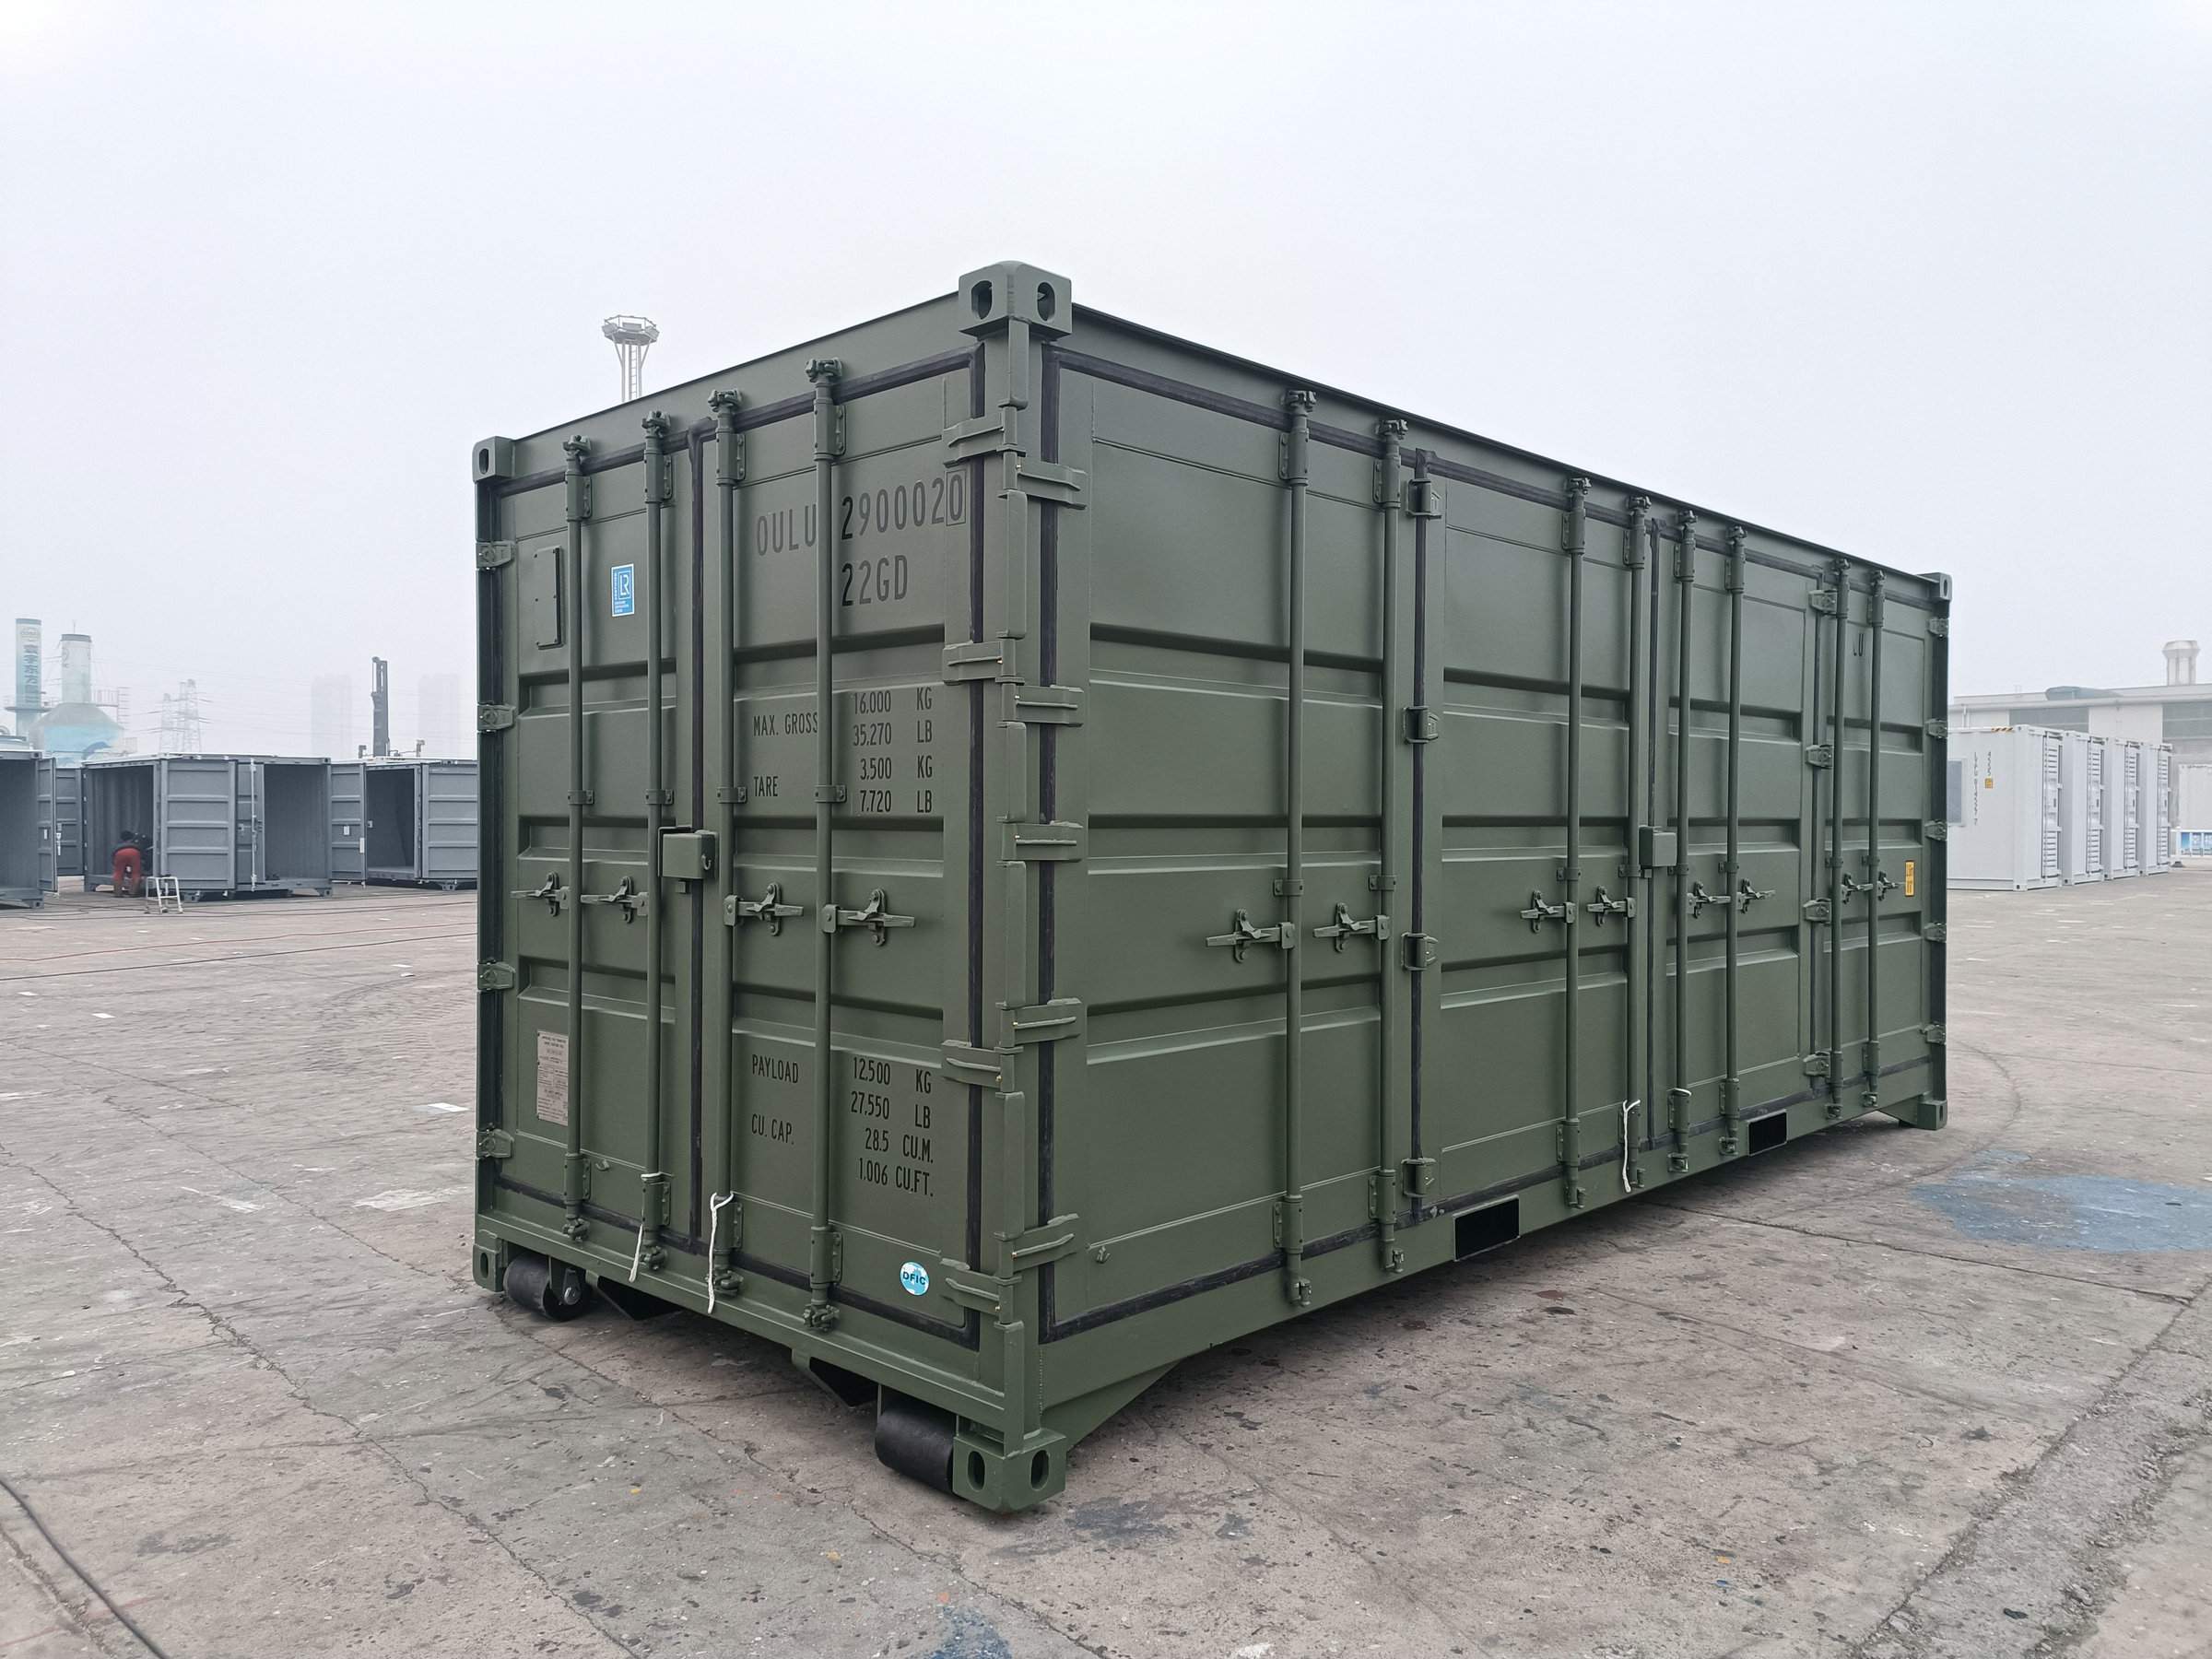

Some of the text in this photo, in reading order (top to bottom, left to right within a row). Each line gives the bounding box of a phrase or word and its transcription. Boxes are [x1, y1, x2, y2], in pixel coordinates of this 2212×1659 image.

[757, 504, 818, 556] OULU
[841, 555, 908, 606] 22GD
[916, 687, 932, 711] KG
[753, 712, 818, 736] MAX. GROSS
[917, 720, 932, 743] LB
[917, 755, 933, 779] KG
[753, 775, 779, 797] TARE
[917, 790, 932, 813] LB
[752, 1053, 799, 1084] PAYLOAD
[915, 1069, 932, 1094] KG
[914, 1104, 931, 1129] LB
[751, 1113, 794, 1145] CU. CAP.
[865, 1127, 889, 1152] 28.5
[903, 1272, 926, 1286] DFIC
